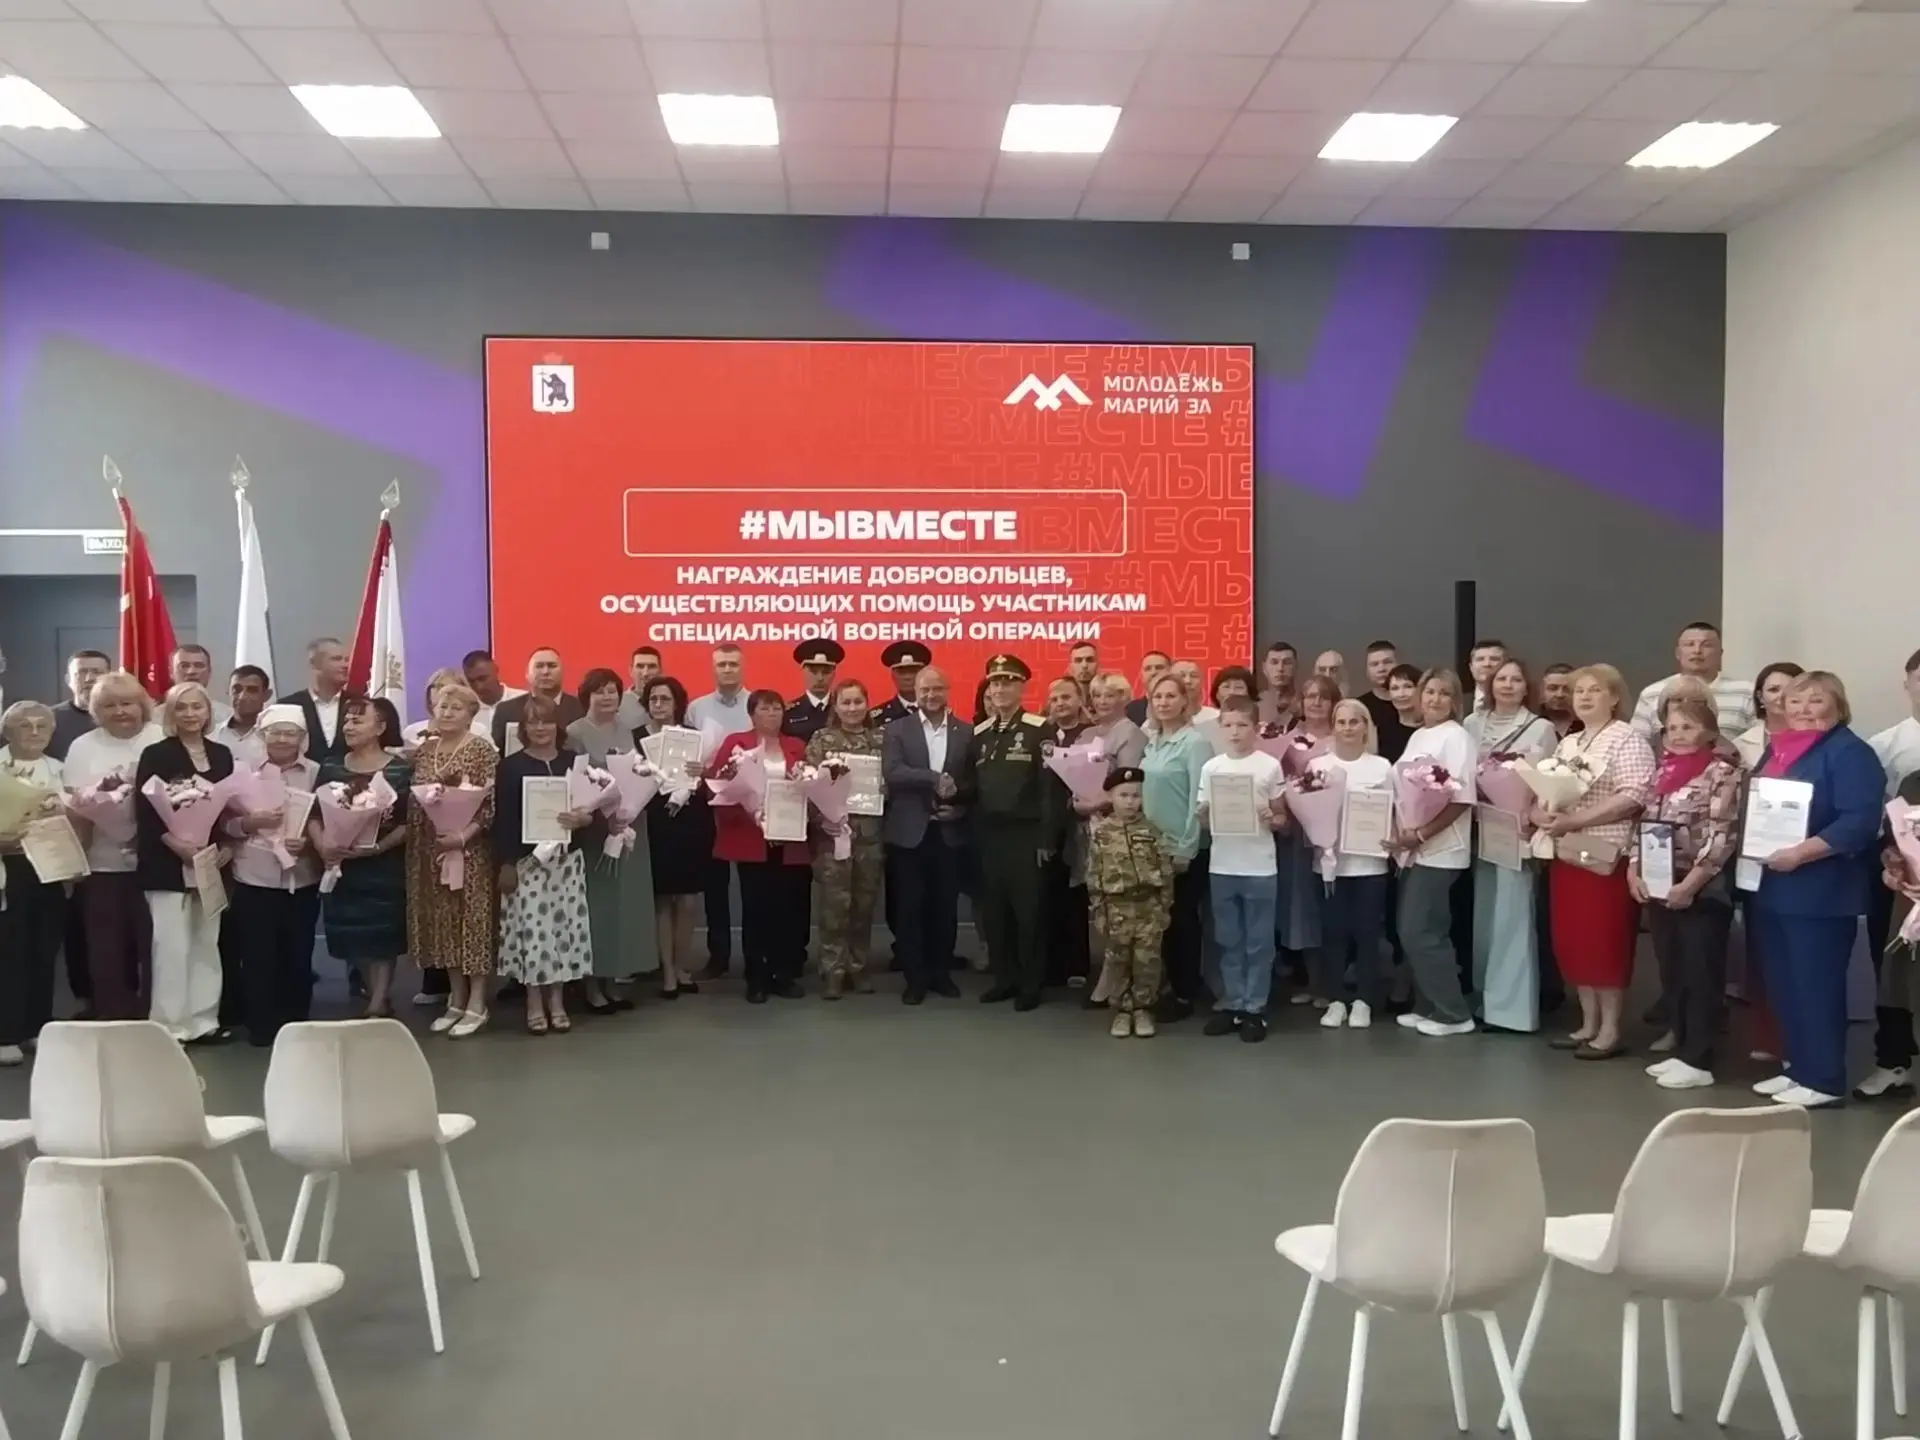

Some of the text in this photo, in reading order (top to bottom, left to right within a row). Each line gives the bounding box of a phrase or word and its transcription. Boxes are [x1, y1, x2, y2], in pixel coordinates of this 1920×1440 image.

[1104, 373, 1223, 392] МОЛОДЁЖЬ
[1104, 395, 1179, 414] МАРИЙ
[739, 509, 1018, 540] #МЫВМЕСТЕ
[88, 538, 122, 549] ВЫХО
[676, 565, 862, 587] НАГРАЖДЕНИЕ
[867, 566, 1073, 587] ДОБРОВОЛЬЦЕВ,
[600, 593, 1147, 616] ОСУЩЕСТВЛЯЮЩИХ ПОМОЩЬ УЧАСТНИКАМ
[648, 618, 1101, 644] СПЕЦИАЛЬНОЙ ВОЕННОЙ ОПЕРАЦИИ
